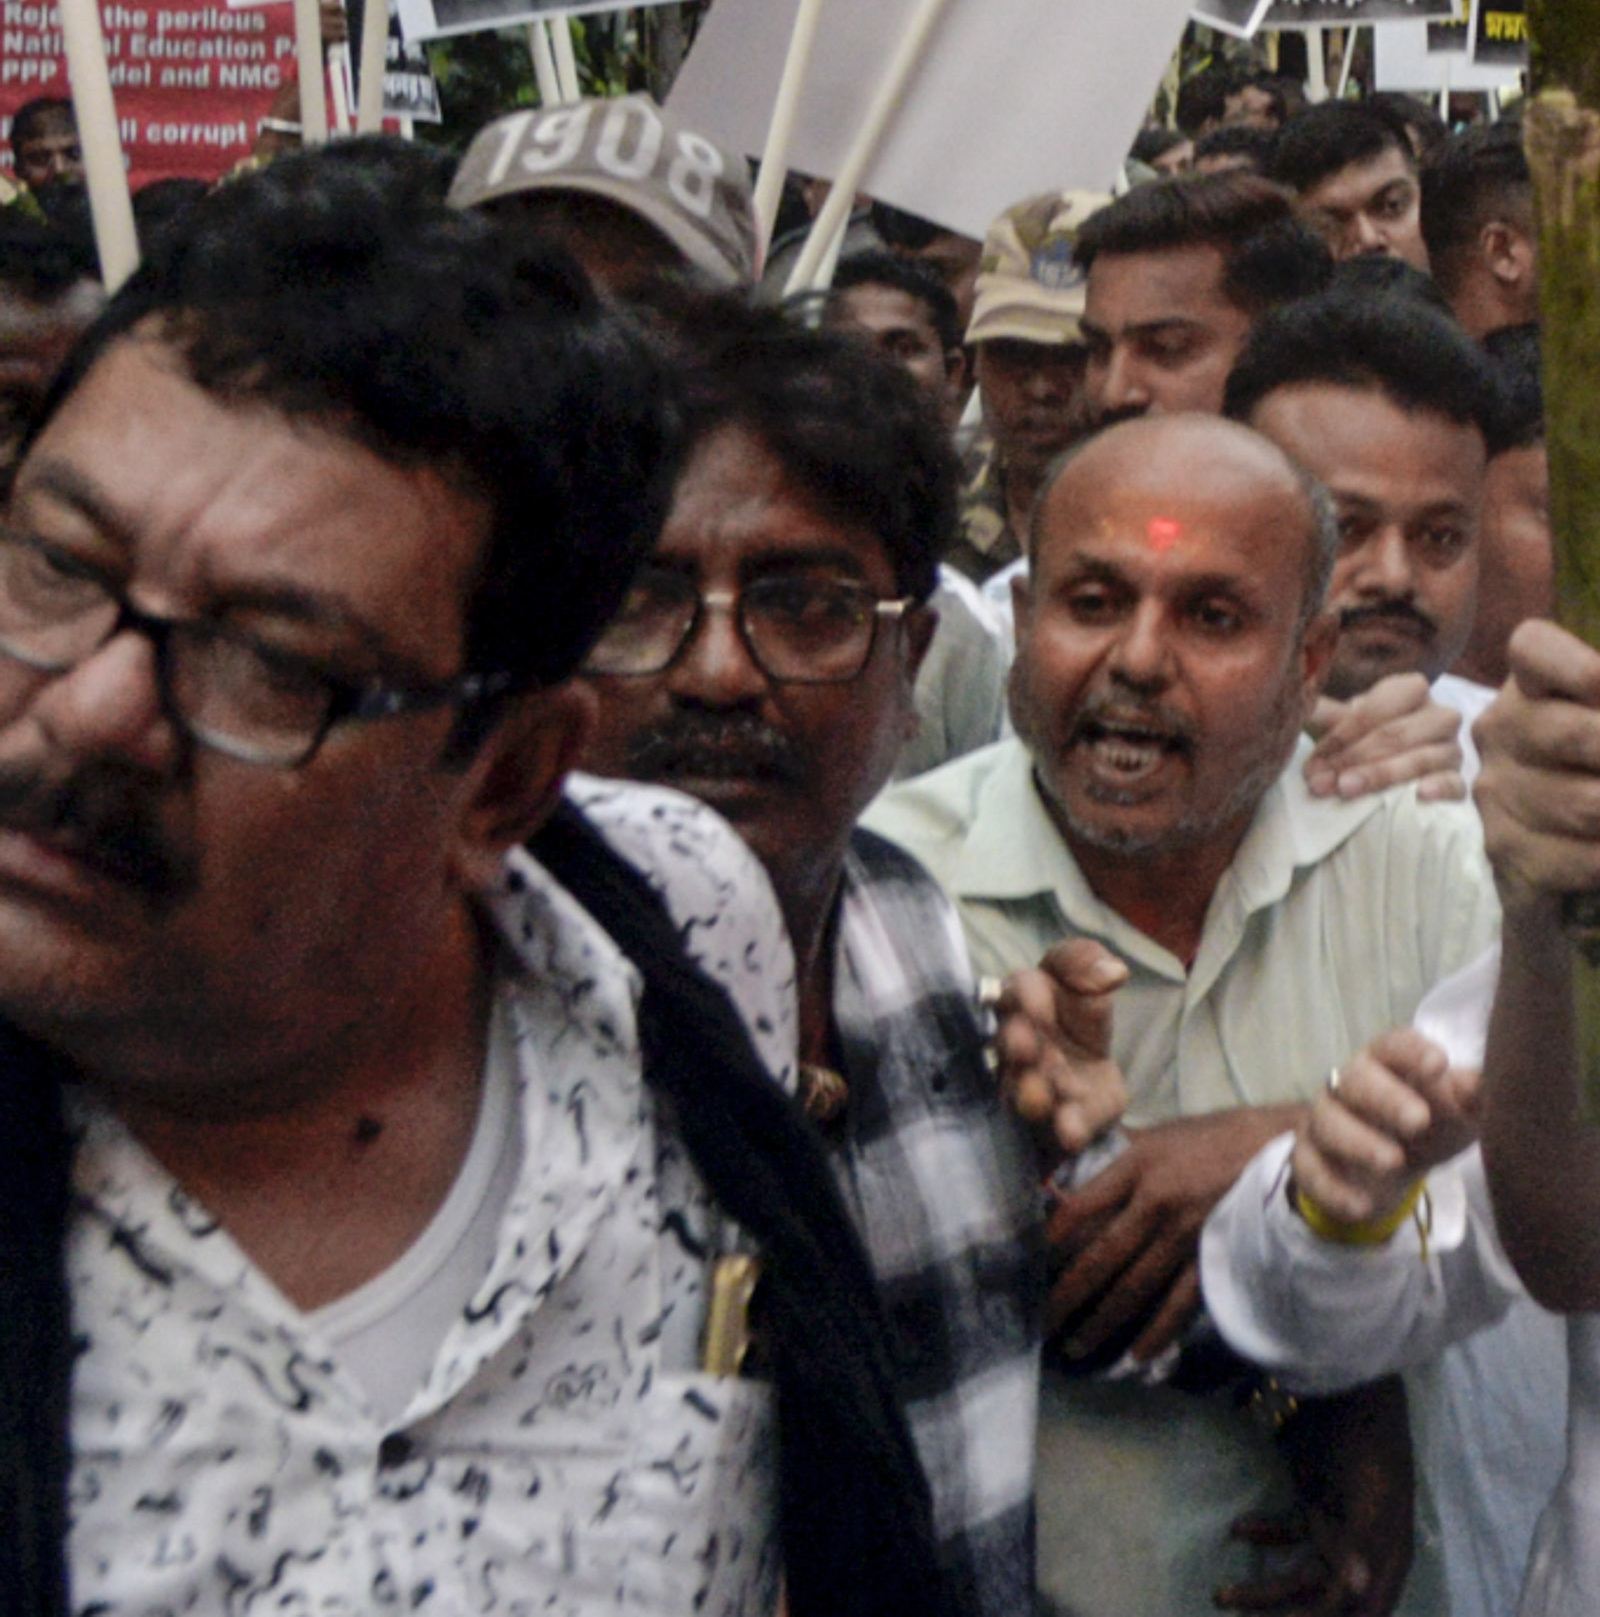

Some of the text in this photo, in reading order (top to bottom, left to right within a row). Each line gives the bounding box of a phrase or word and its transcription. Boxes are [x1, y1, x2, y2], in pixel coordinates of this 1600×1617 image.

[104, 3, 148, 30] the
[157, 7, 266, 33] perilous
[130, 34, 266, 60] Education
[2, 58, 57, 83] PPP
[161, 64, 209, 89] and
[220, 64, 281, 89] NMC
[146, 120, 248, 150] corrupt
[487, 97, 725, 218] 1908
